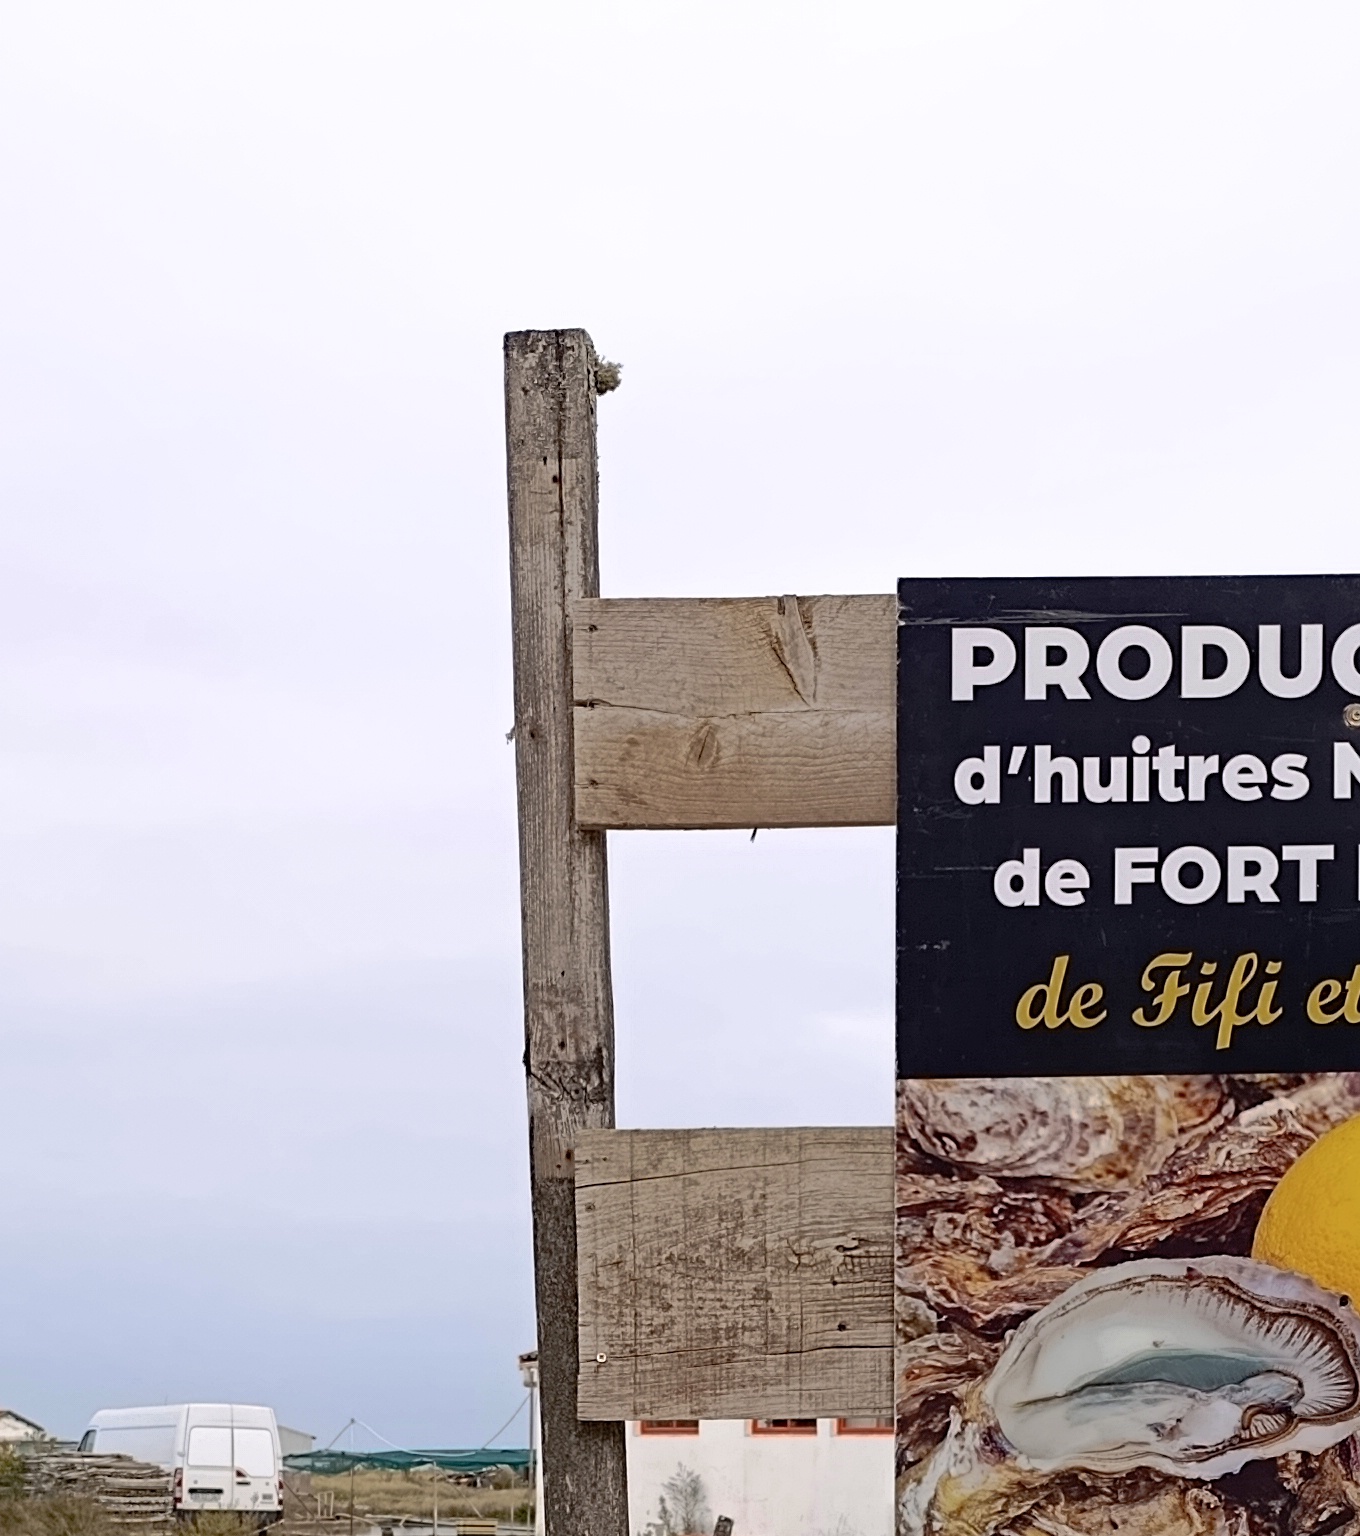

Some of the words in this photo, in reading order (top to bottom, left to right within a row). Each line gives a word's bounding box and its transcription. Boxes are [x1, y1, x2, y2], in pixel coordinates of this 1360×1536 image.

[994, 848, 1090, 907] de
[1115, 845, 1334, 905] FORT
[1016, 956, 1106, 1030] de
[1132, 951, 1283, 1050] Fifi
